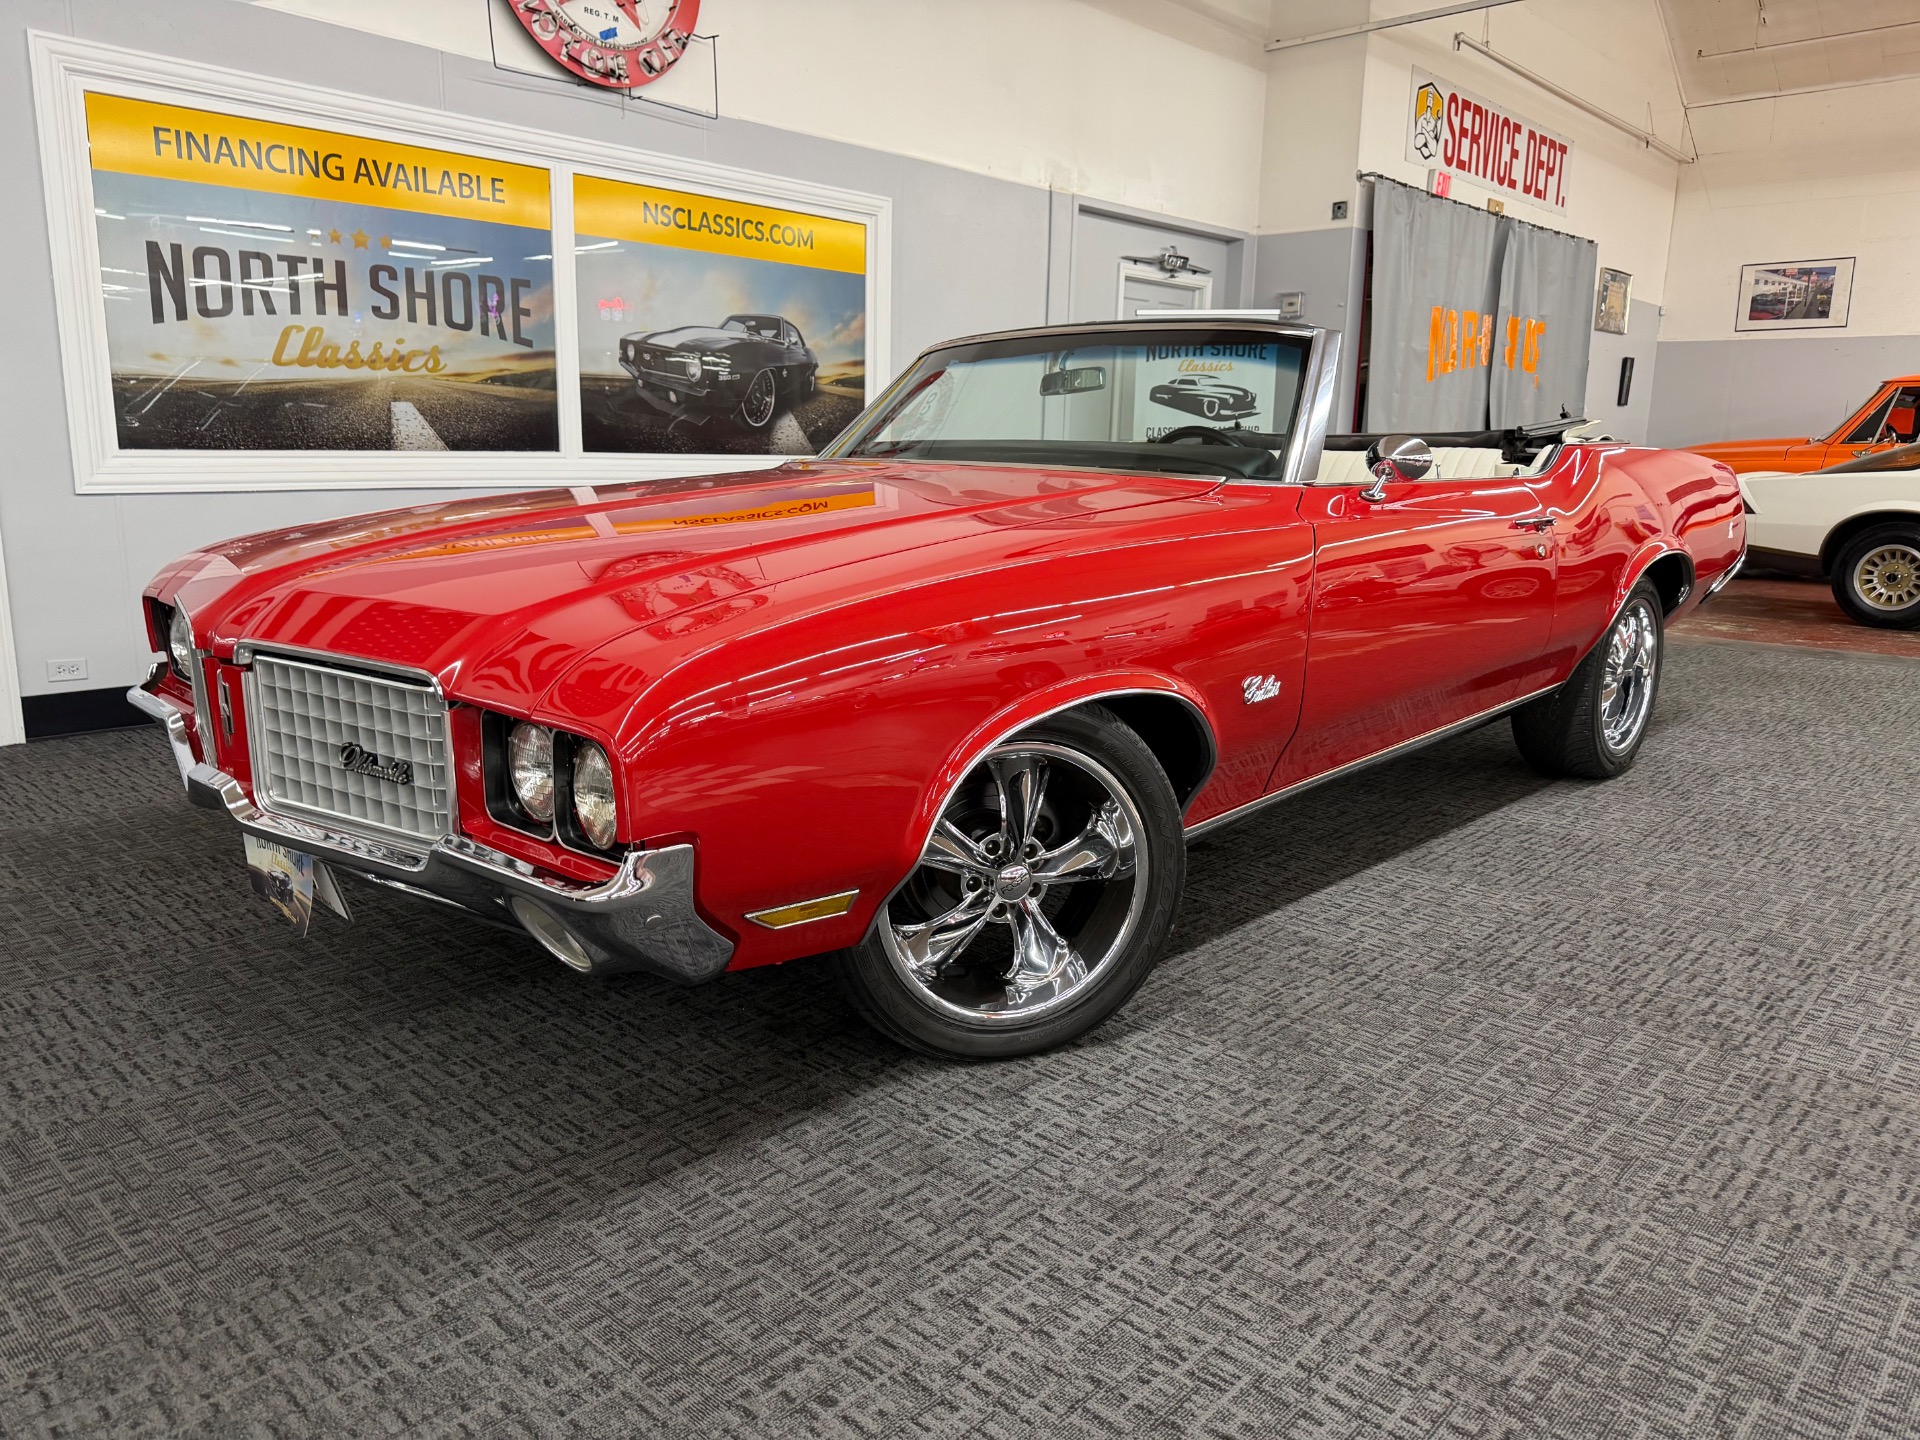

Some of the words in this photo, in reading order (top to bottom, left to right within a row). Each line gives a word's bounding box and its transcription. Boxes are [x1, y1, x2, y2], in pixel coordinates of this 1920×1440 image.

[517, 0, 631, 84] OTOR
[584, 34, 598, 45] THE
[153, 126, 346, 182] FINANCING
[353, 157, 506, 204] AVAILABLE
[1443, 92, 1522, 190] SERVICE
[1522, 129, 1568, 208] DEPT.
[643, 201, 814, 250] NSCLASSICS.COM
[145, 240, 349, 325] NORTH
[368, 263, 534, 349] SHORE
[271, 324, 447, 374] Classics
[1146, 345, 1204, 363] NORTH
[1210, 345, 1267, 361] SHORE
[1177, 360, 1235, 373] Classics
